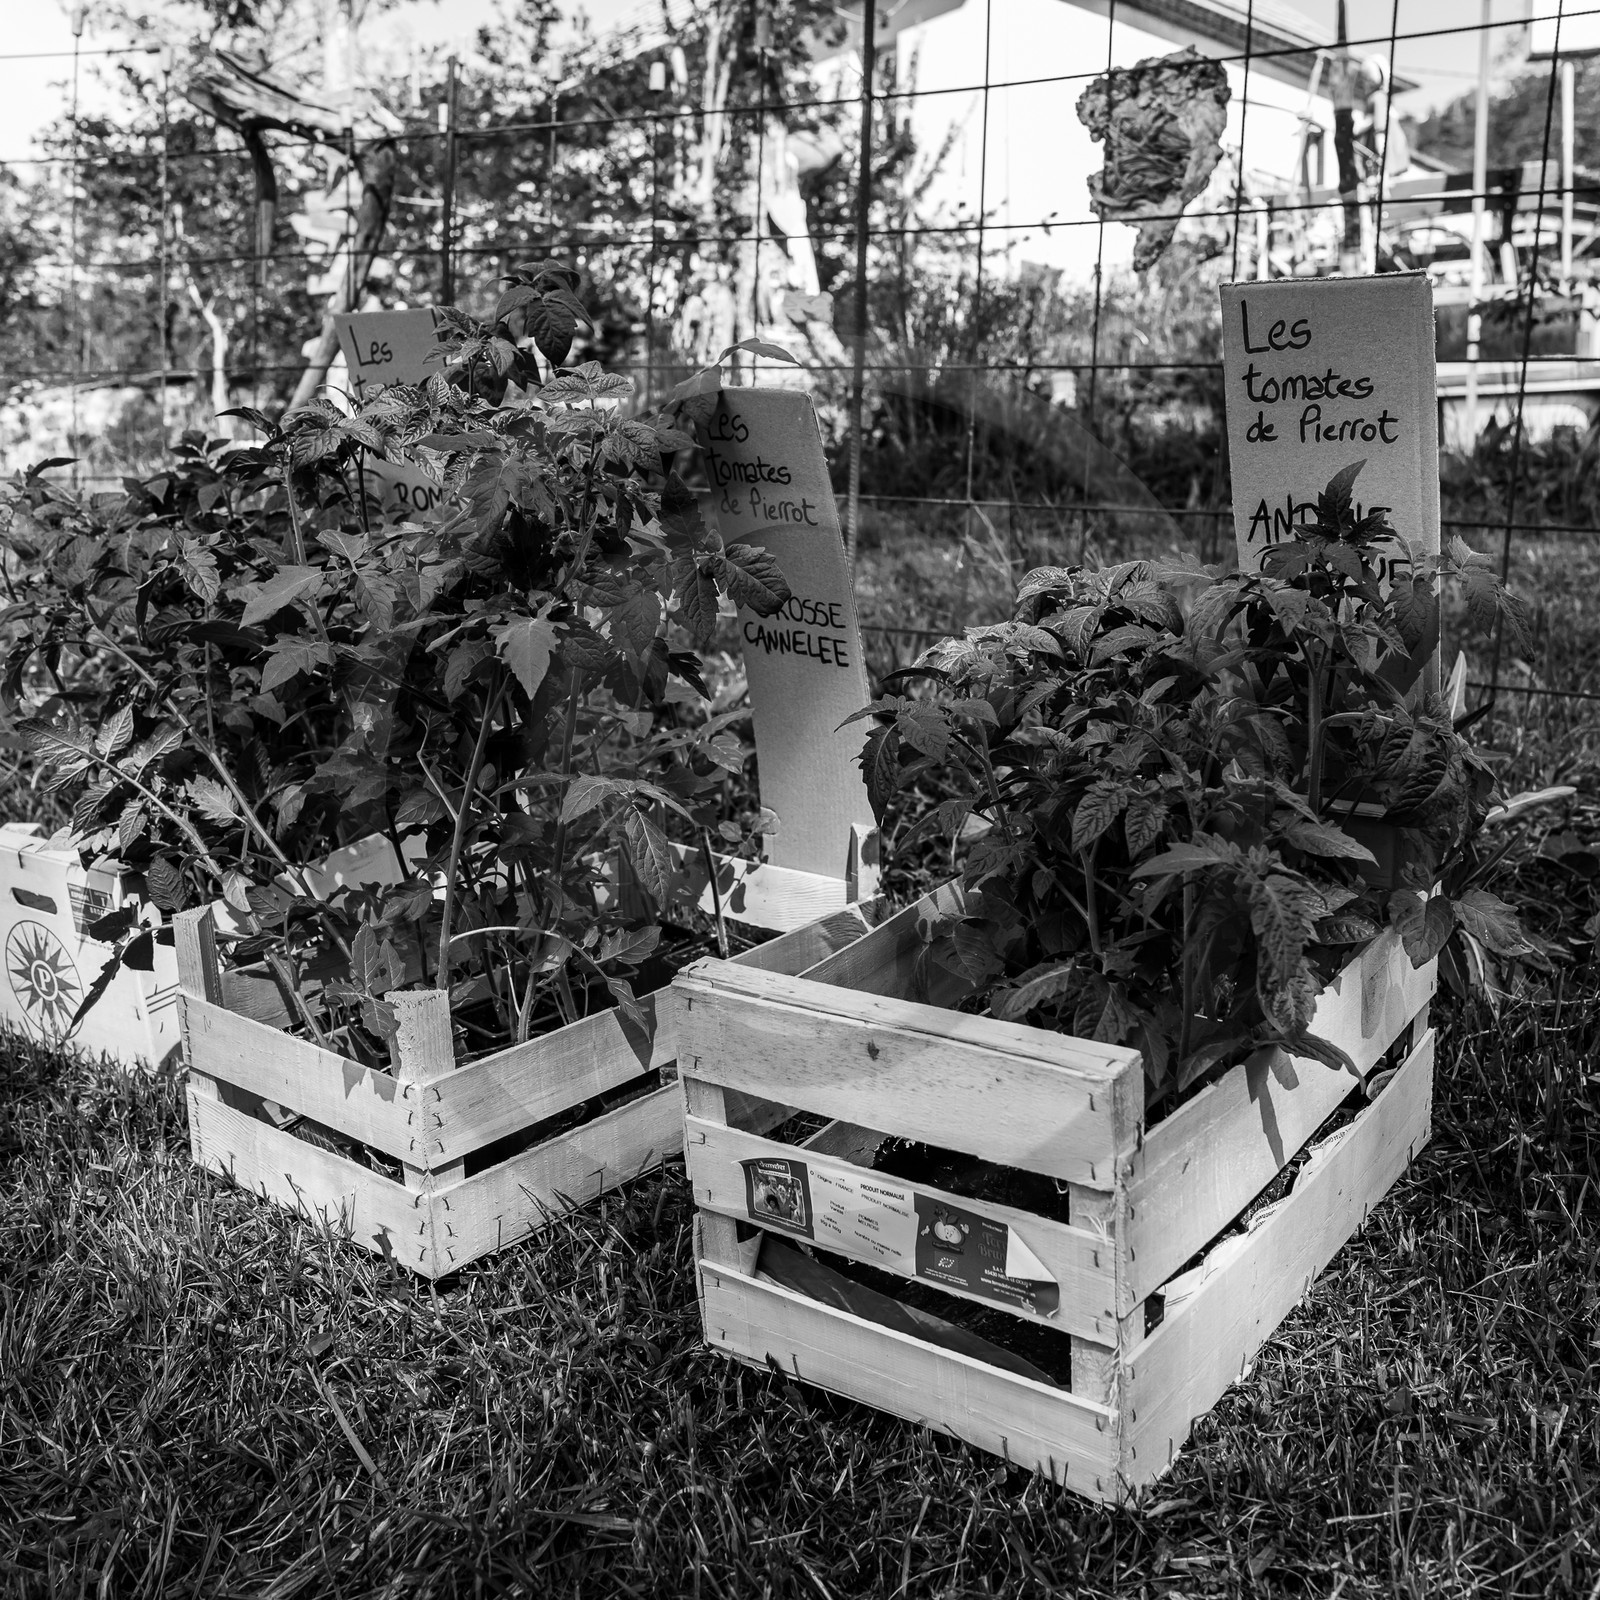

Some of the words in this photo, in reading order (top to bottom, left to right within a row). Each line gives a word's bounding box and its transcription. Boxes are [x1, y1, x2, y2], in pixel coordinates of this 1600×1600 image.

[348, 324, 393, 367] Les
[1241, 299, 1312, 354] Les
[1242, 363, 1374, 403] tomates
[1245, 411, 1279, 443] de
[1299, 403, 1399, 444] Pierrot
[393, 481, 443, 512] ROM
[720, 488, 742, 516] de
[749, 486, 818, 527] Pierrot
[743, 621, 850, 668] CANNELEE
[860, 1183, 879, 1194] PRODUIT
[861, 1193, 882, 1206] PRODUIT
